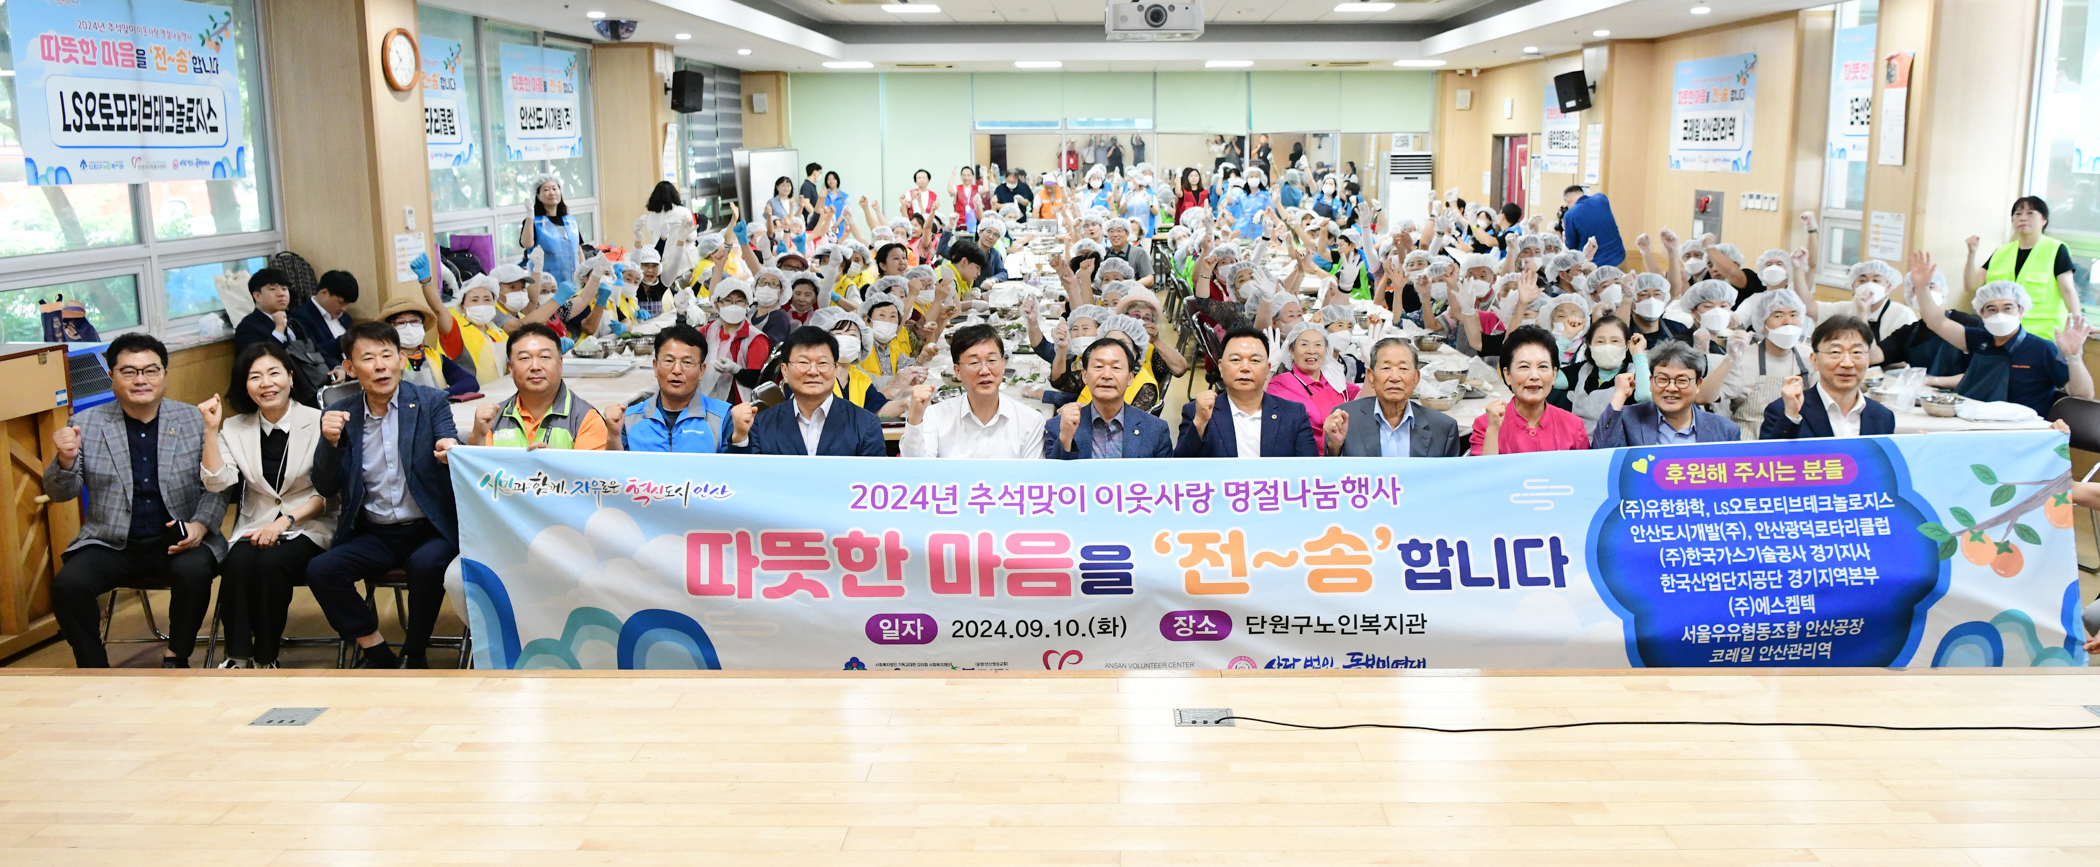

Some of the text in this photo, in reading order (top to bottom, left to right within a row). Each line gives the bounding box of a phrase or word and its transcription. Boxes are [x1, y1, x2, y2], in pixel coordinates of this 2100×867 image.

[77, 20, 106, 33] 2024년
[108, 21, 136, 35] 추석맞이
[39, 34, 98, 66] 따뜻한
[101, 40, 147, 69] 마음을
[59, 91, 218, 134] LS오토모티브테크놀로지스
[520, 106, 573, 131] 안산도시개발(주)
[1665, 459, 1844, 485] 후원해 주시는 분들
[570, 480, 621, 507] 자유로운
[625, 479, 691, 506] 혁신도시
[693, 483, 733, 499] 안산
[850, 475, 1401, 515] 2024년 추석맞이 이웃사랑 명절나눔행사
[1619, 491, 1895, 520] (주)유한화학, LS오토모티브테크놀로지스
[1630, 516, 1891, 543] 안산도시개발(주), 안산광덕로타리클럽
[686, 531, 909, 600] 따뜻한
[928, 531, 1134, 597] 마음을
[1660, 543, 1870, 568] (주)한국가스기술공사 경기지사
[1660, 566, 1880, 593] 한국산업단지공단 경기지역본부
[1729, 594, 1816, 617] (주)에스켐텍
[879, 615, 1127, 640] 일자 2024.09.10.(화)
[1173, 613, 1427, 637] 장소 단원구노인복지관
[1681, 618, 1864, 644] 서울우유협동조합 안산공장
[1709, 642, 1832, 663] 코레일 안산관리역
